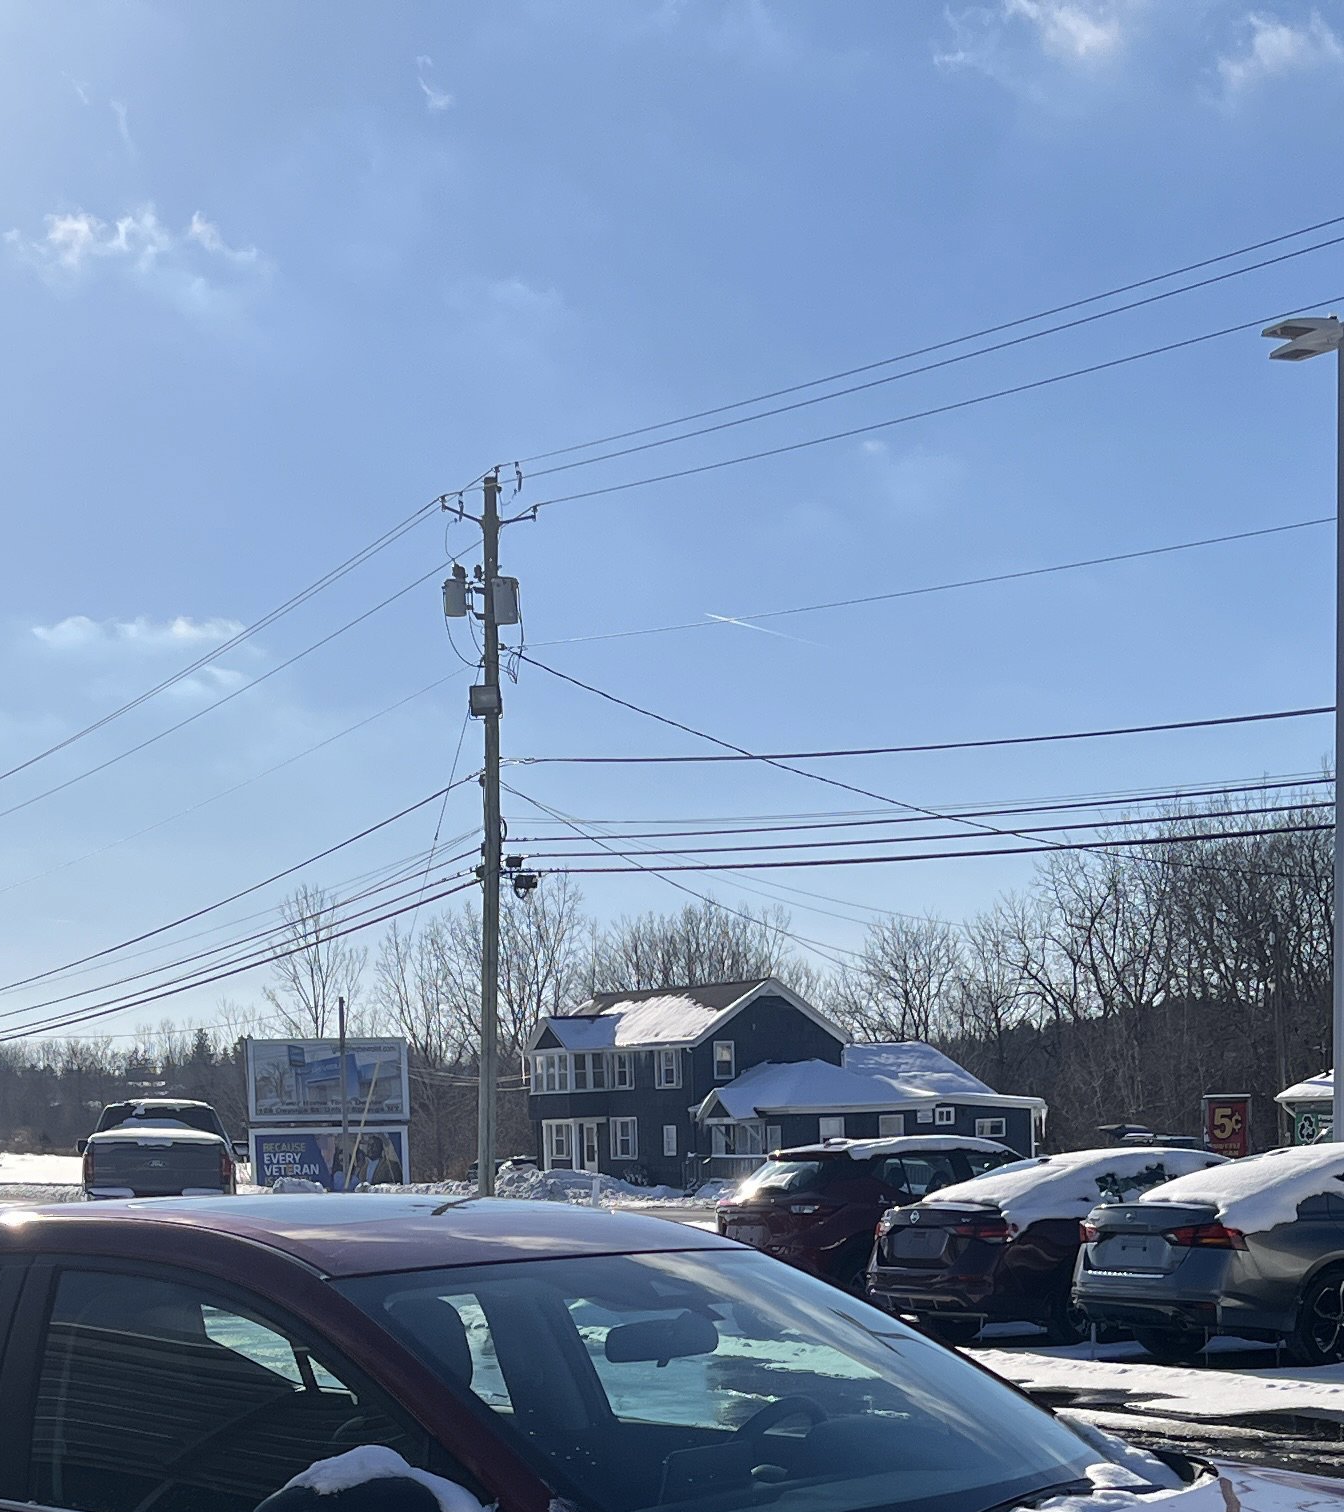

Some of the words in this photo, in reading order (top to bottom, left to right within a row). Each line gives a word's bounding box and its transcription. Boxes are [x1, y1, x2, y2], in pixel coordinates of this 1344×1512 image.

[1213, 1107, 1242, 1139] 5¢
[263, 1142, 306, 1152] BECAUSE
[263, 1152, 302, 1164] EVERY
[263, 1163, 319, 1176] VETERAN
